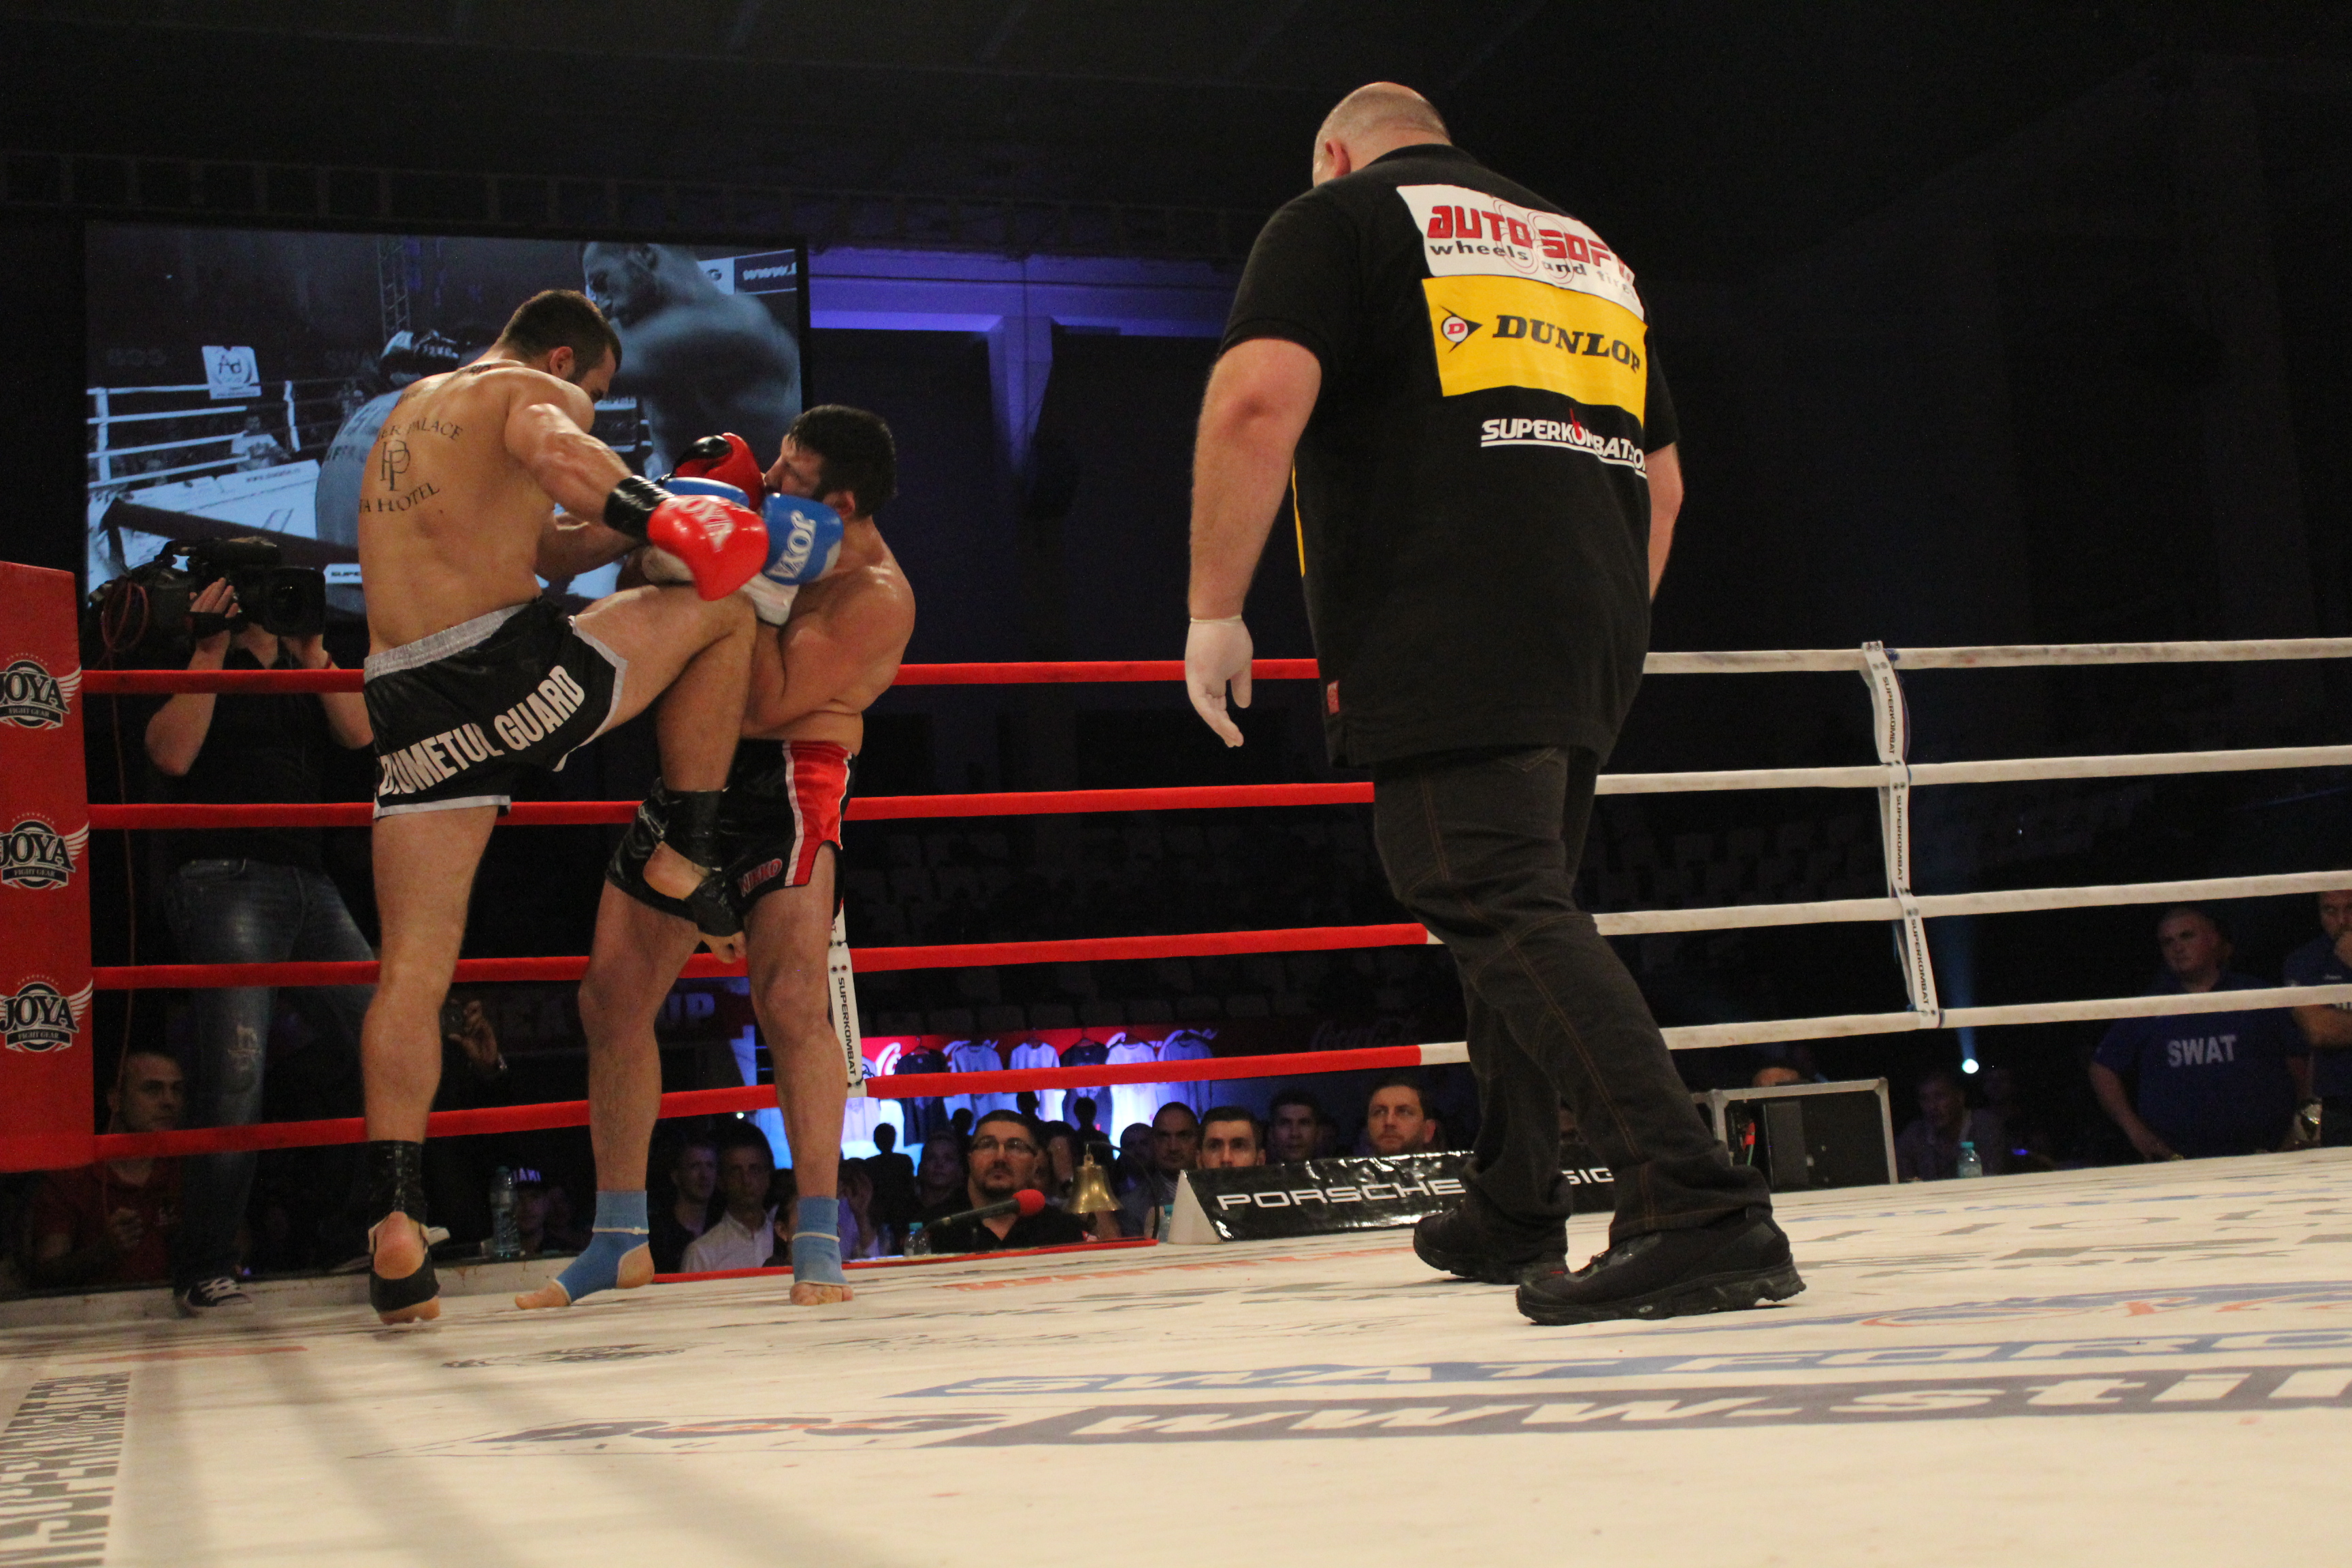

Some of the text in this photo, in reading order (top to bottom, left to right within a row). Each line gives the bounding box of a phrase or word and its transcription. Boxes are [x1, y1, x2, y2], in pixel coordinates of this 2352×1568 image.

[1427, 205, 1533, 249] AUTO
[1430, 240, 1529, 261] wheels
[1542, 260, 1587, 276] and
[1492, 314, 1641, 374] DUNLOP
[377, 481, 441, 512] HOTEL
[494, 665, 585, 751] GUARD
[1882, 676, 1897, 755] SUPERKOMBAT
[1910, 919, 1929, 1005] SUPERKOMBAT
[0, 994, 80, 1034] JOYA
[838, 977, 857, 1077] SUPERKOMBAT
[2168, 1034, 2237, 1068] SWAT
[1216, 1179, 1467, 1211] PORSCHE
